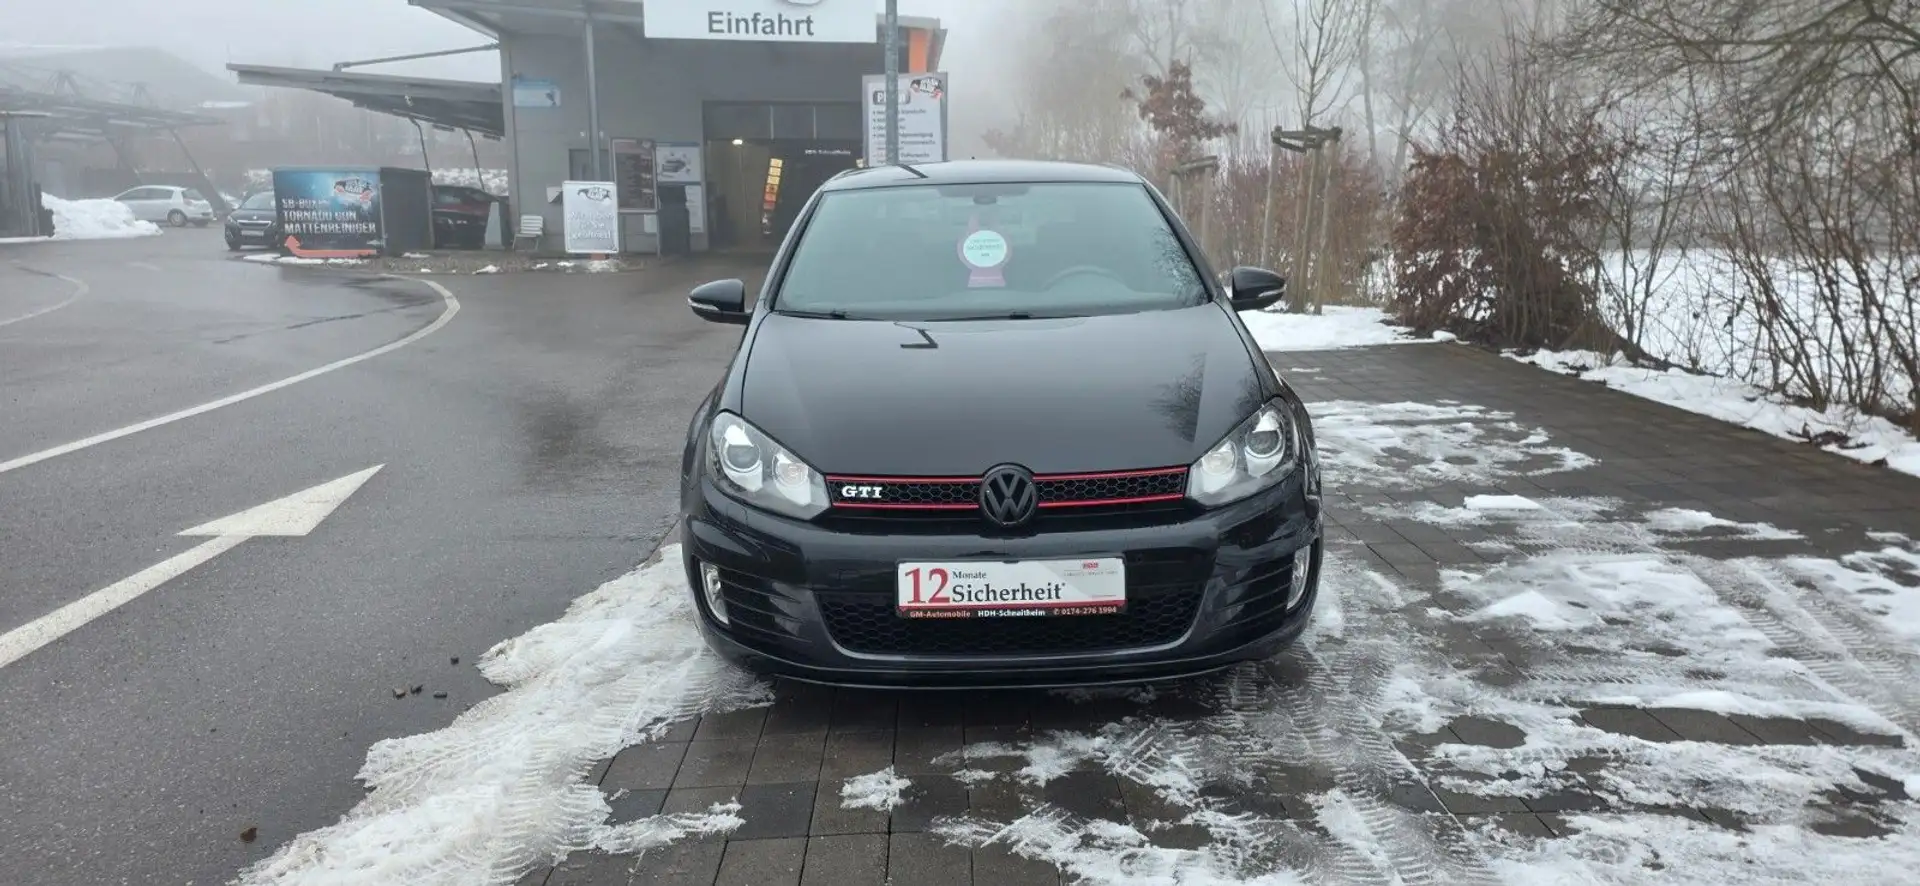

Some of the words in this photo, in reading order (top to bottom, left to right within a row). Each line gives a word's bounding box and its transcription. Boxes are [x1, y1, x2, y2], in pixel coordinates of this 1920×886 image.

[708, 11, 814, 36] Einfahrt
[283, 210, 333, 221] TORNADO
[284, 222, 376, 234] MATTENREINIGER
[841, 485, 883, 499] GTI
[904, 567, 951, 604] 12
[952, 570, 987, 580] Monate
[909, 610, 971, 618] GM-Automobile
[977, 608, 1046, 618] HDH-Schnaitheim
